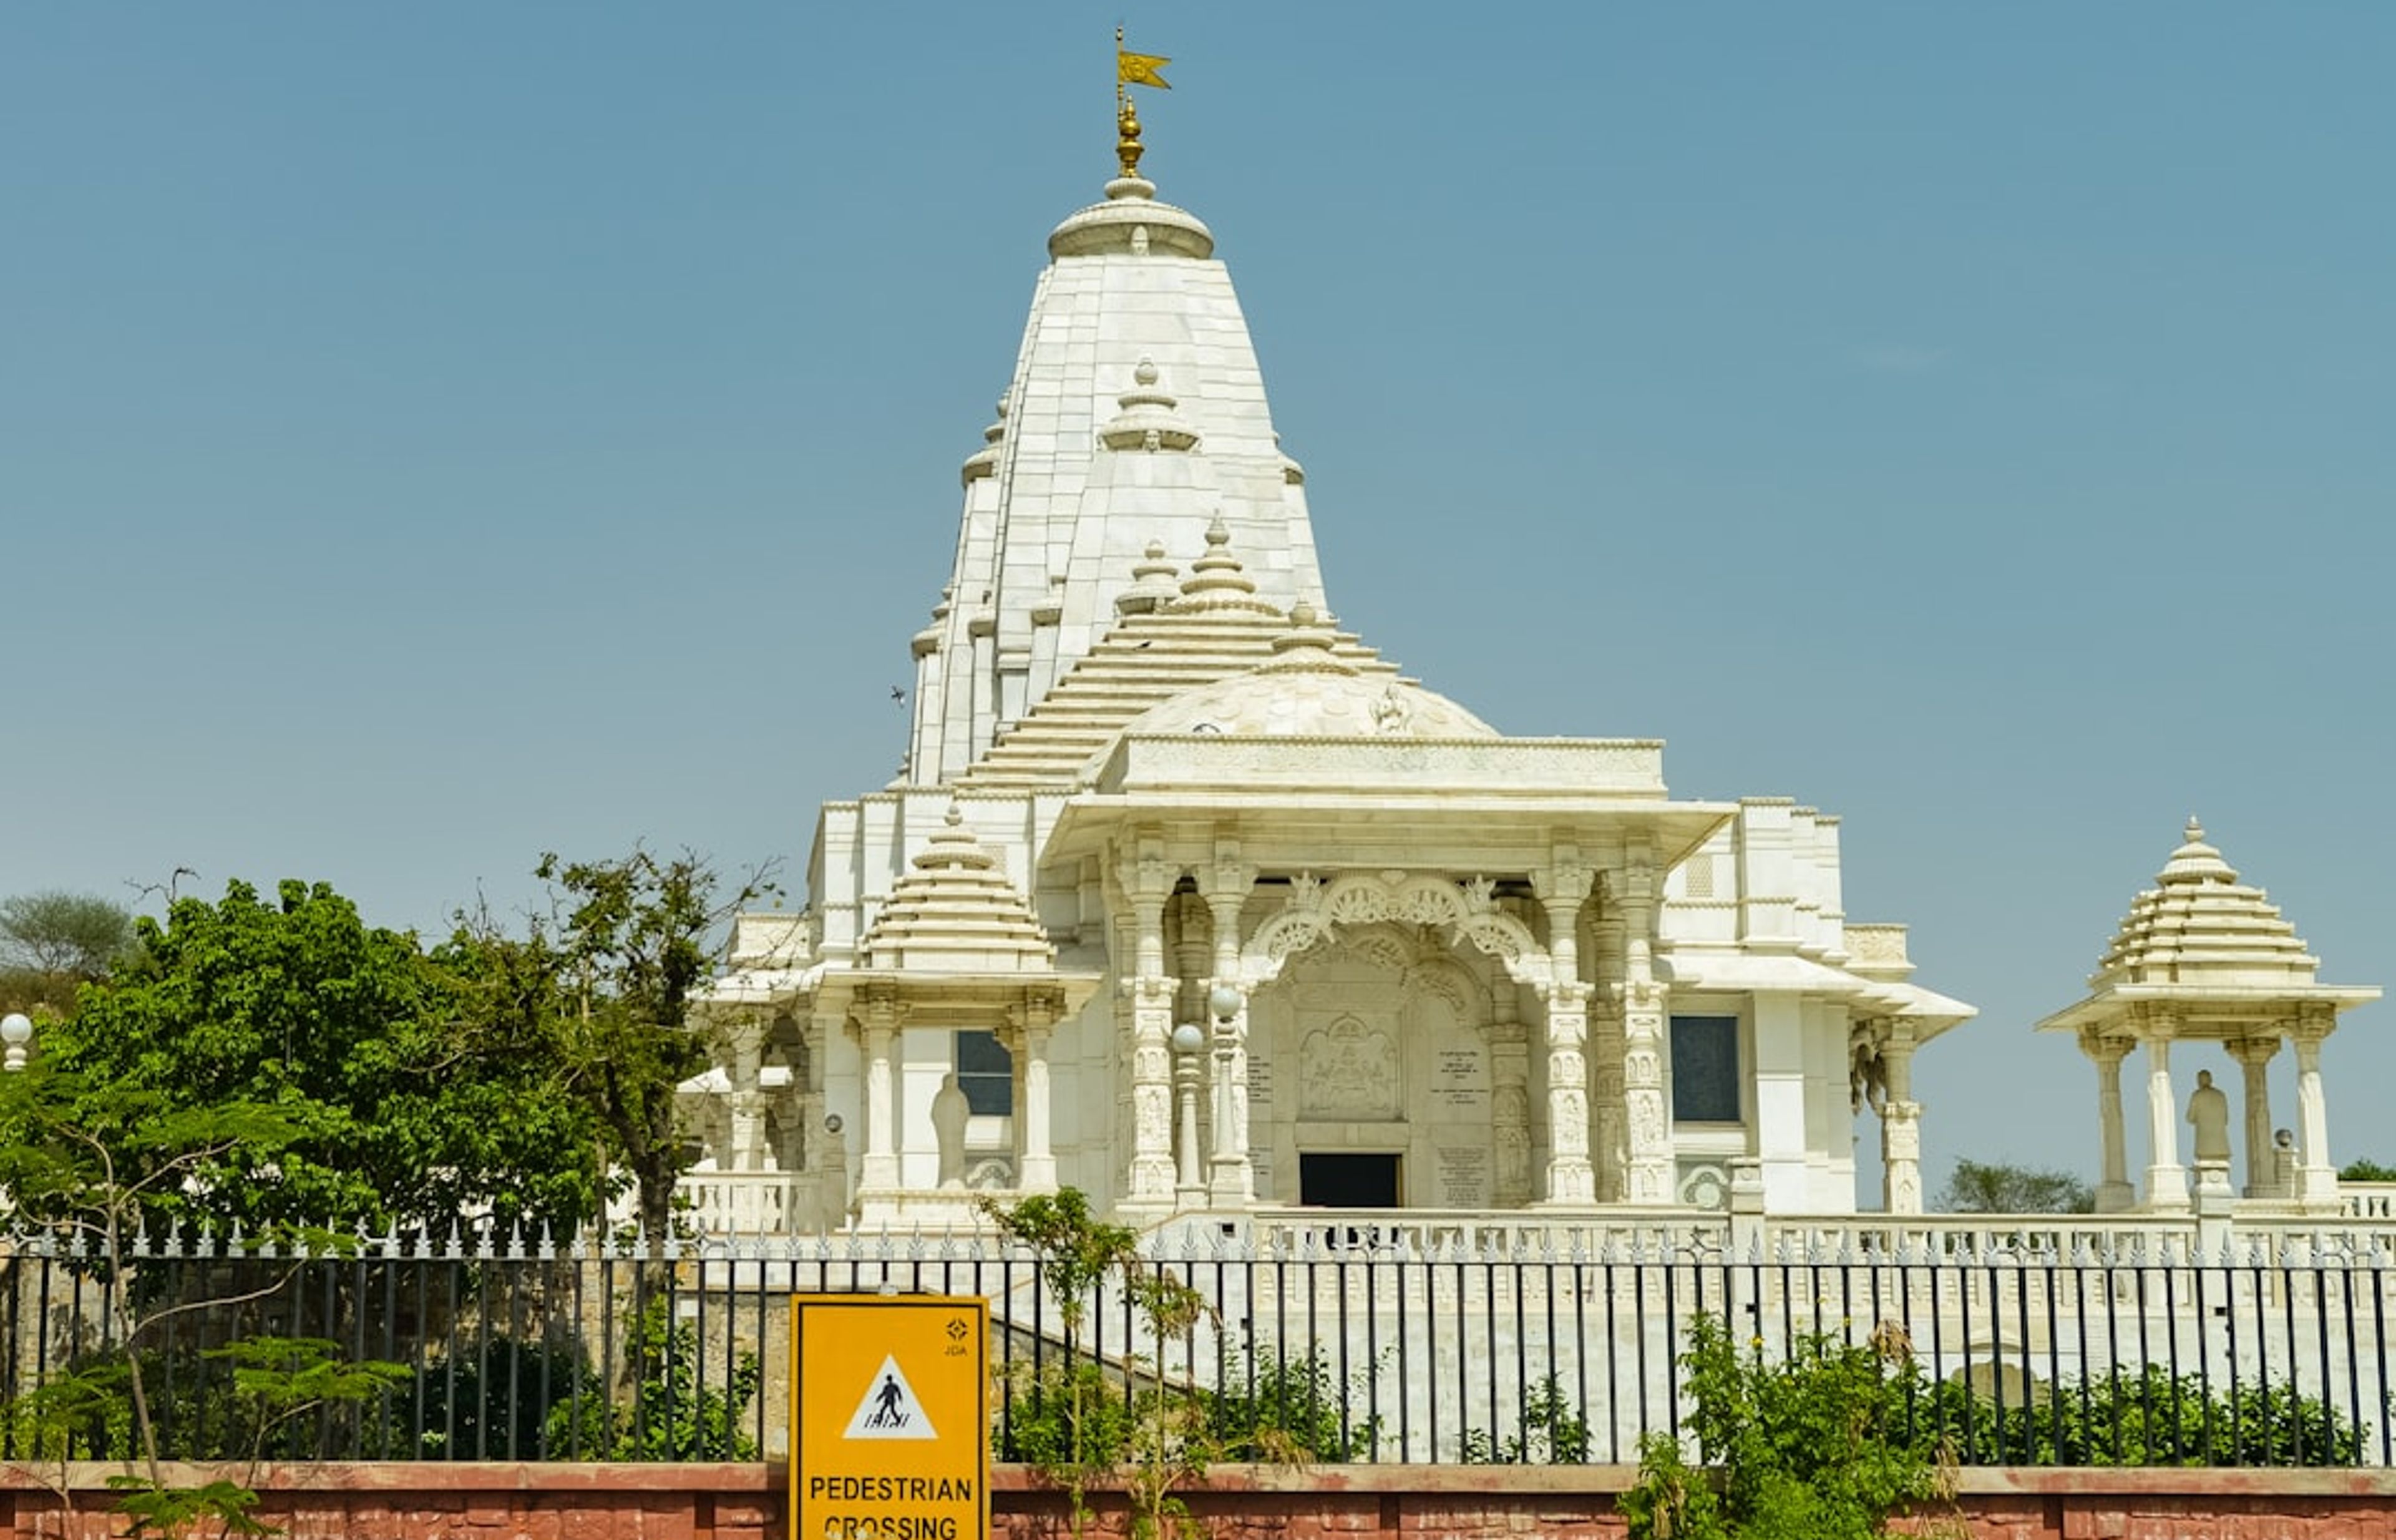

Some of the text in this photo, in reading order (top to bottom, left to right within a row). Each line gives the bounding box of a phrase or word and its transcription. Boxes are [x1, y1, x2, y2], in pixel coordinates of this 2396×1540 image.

[944, 1345, 968, 1357] JDA
[811, 1477, 971, 1501] PEDESTRIAN
[824, 1516, 957, 1540] CROSSING
